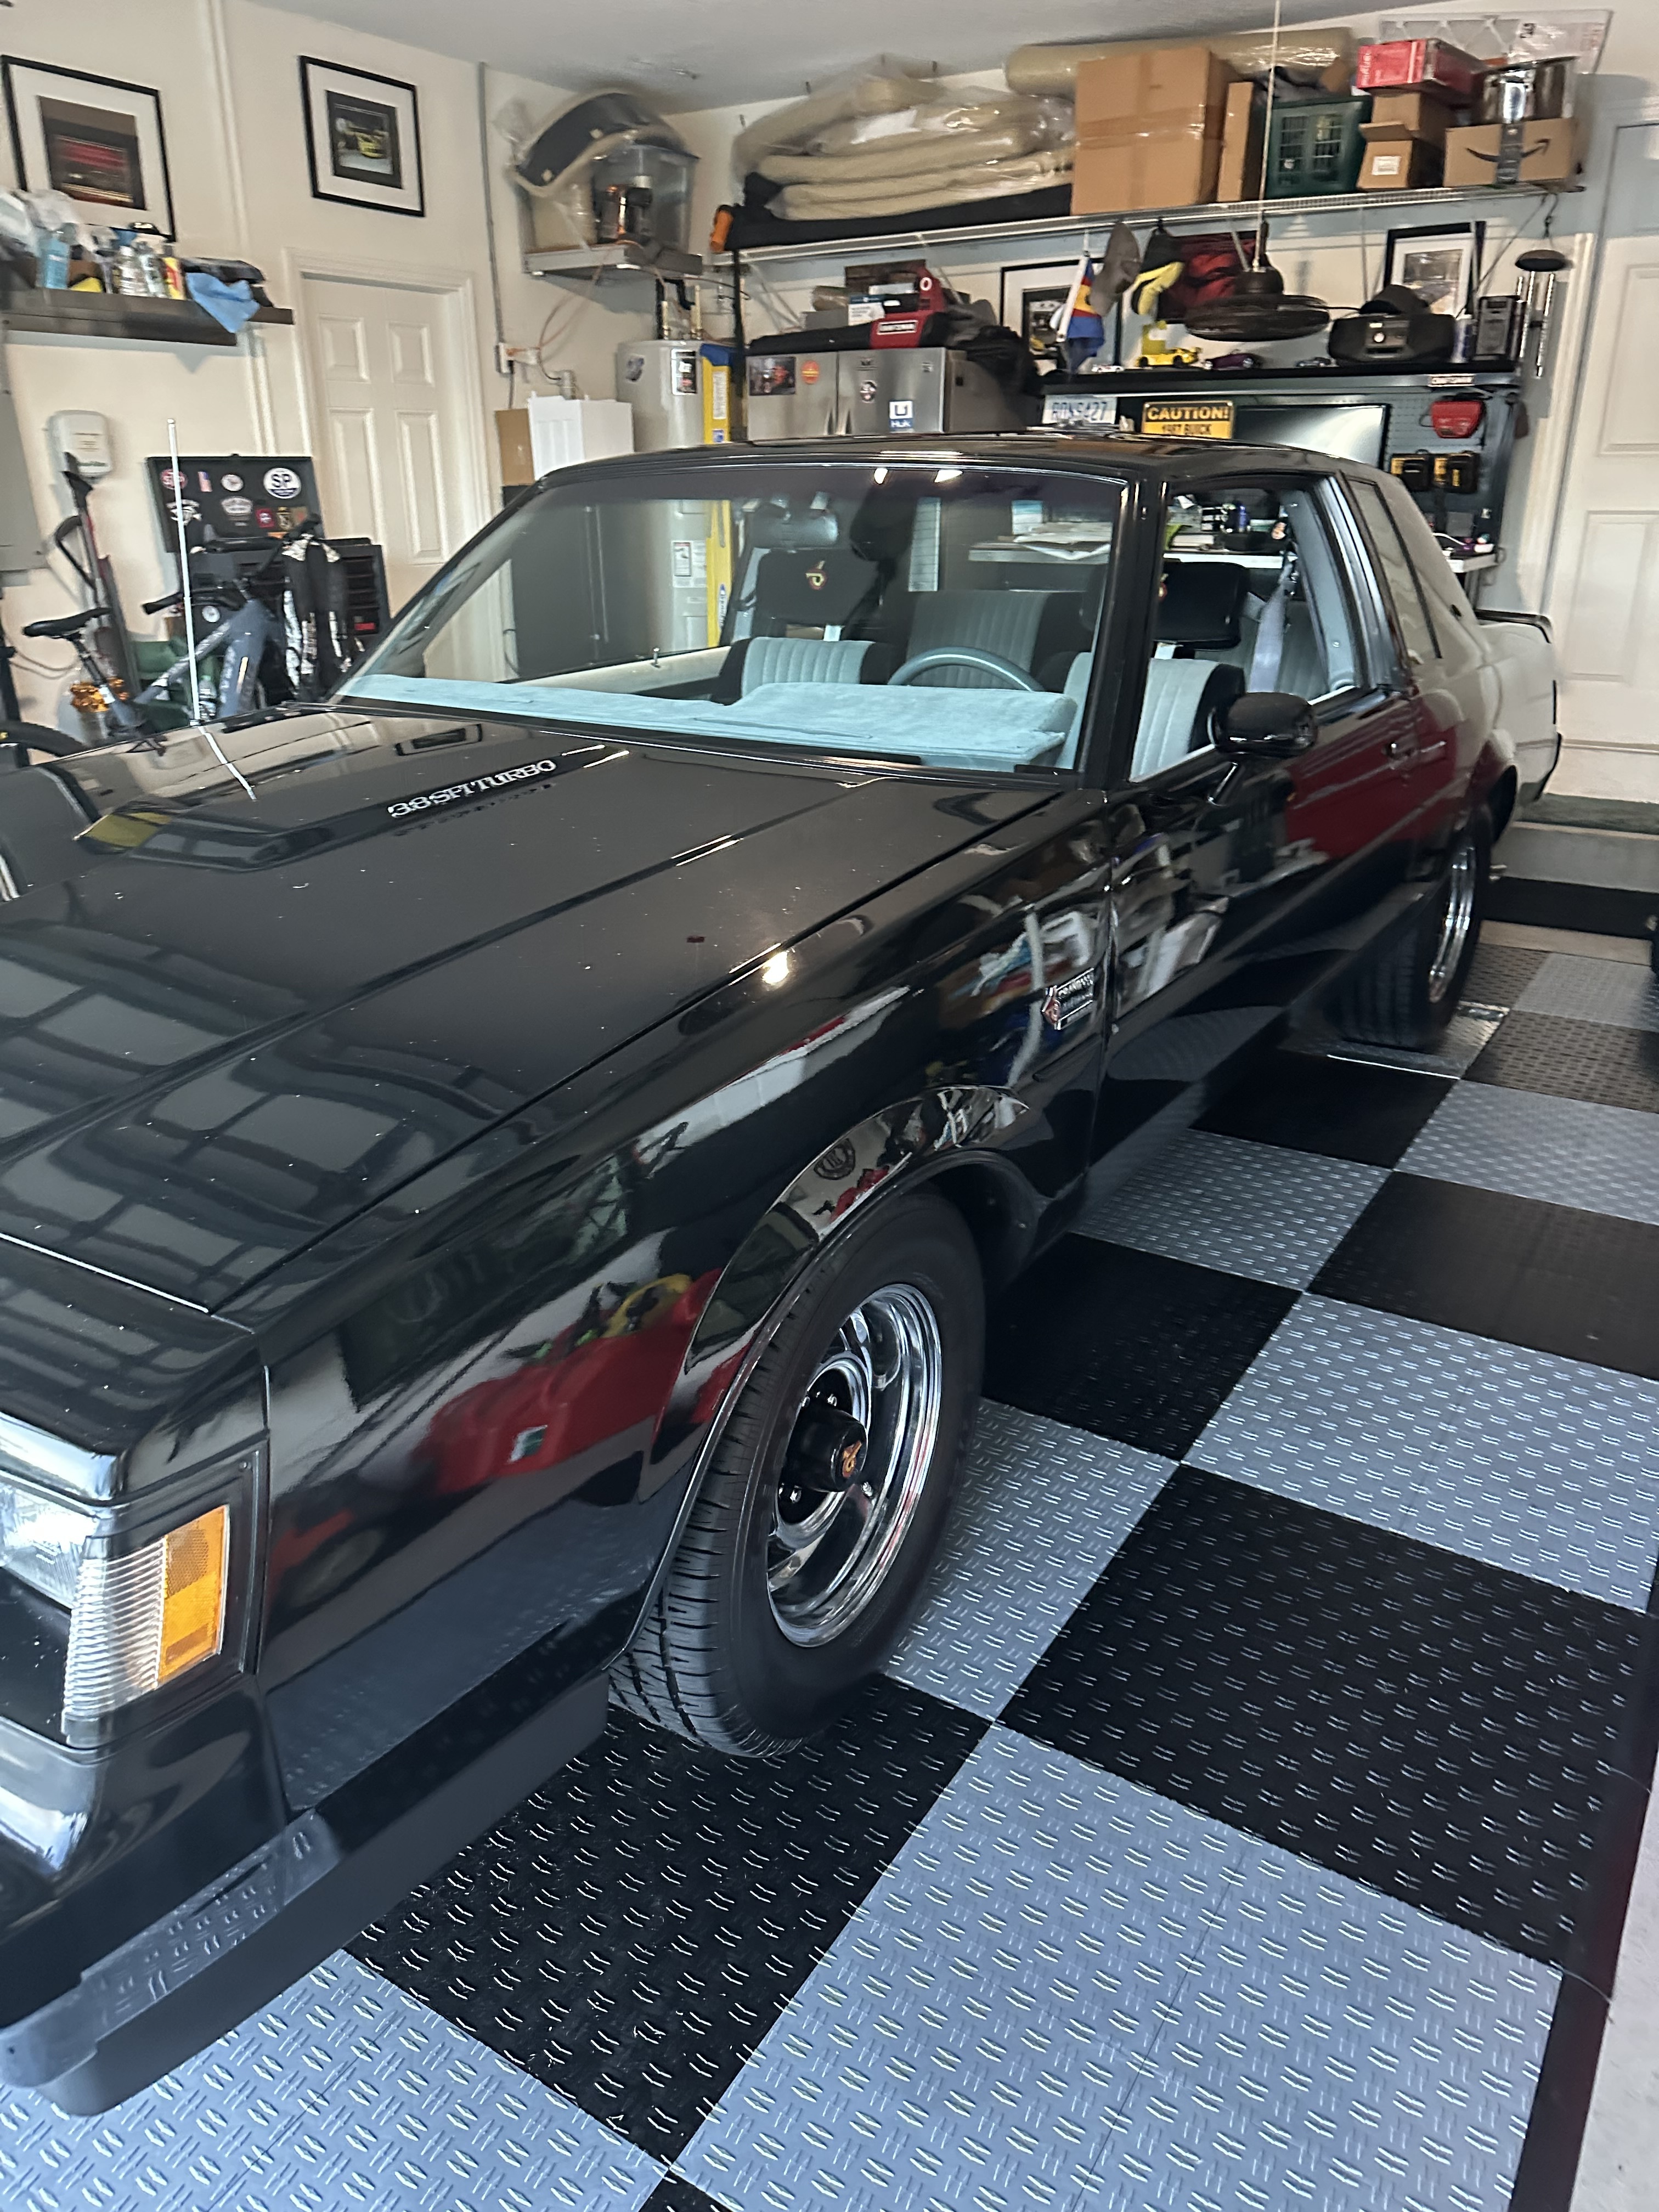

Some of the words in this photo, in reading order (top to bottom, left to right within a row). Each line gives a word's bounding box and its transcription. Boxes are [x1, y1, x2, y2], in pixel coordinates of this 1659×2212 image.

[1147, 407, 1228, 420] CAUTION!
[428, 783, 475, 805] SFI
[470, 760, 556, 792] TURBO
